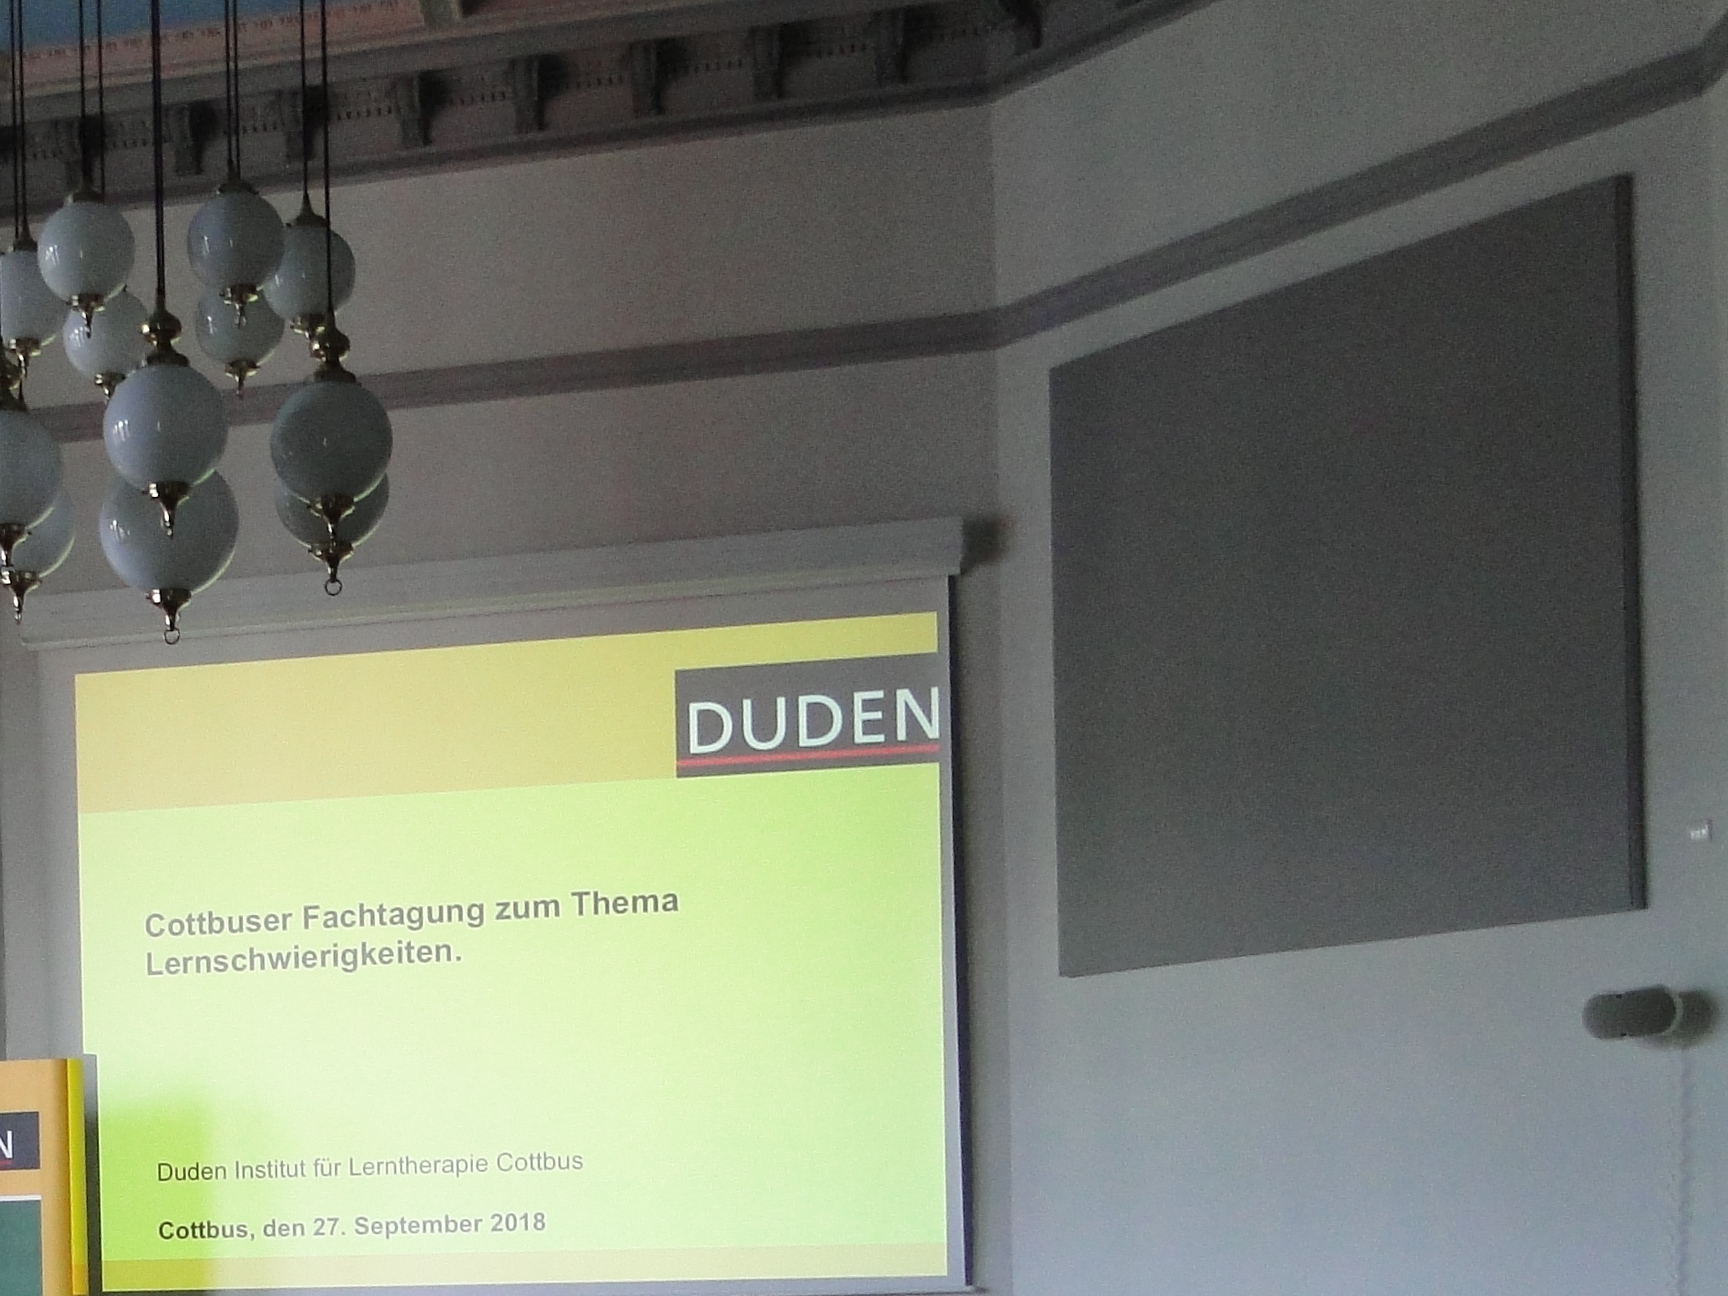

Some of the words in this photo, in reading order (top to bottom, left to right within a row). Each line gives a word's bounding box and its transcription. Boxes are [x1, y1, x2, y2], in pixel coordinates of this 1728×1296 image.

[688, 687, 940, 754] DUDEN
[145, 910, 293, 938] Cottbuser
[303, 902, 485, 932] Fachtagung
[494, 898, 561, 921] zum
[571, 890, 680, 917] Thema
[146, 939, 462, 977] Lernschwierigkeiten.
[157, 1161, 227, 1182] Duden
[234, 1159, 307, 1180] Institut
[313, 1157, 342, 1178] für
[349, 1153, 489, 1179] Lerntherapie
[496, 1151, 584, 1173] Cottbus
[158, 1220, 256, 1242] Cottbus,
[263, 1218, 306, 1238] den
[313, 1217, 347, 1237] 27.
[354, 1214, 483, 1240] September
[490, 1212, 547, 1233] 2018
